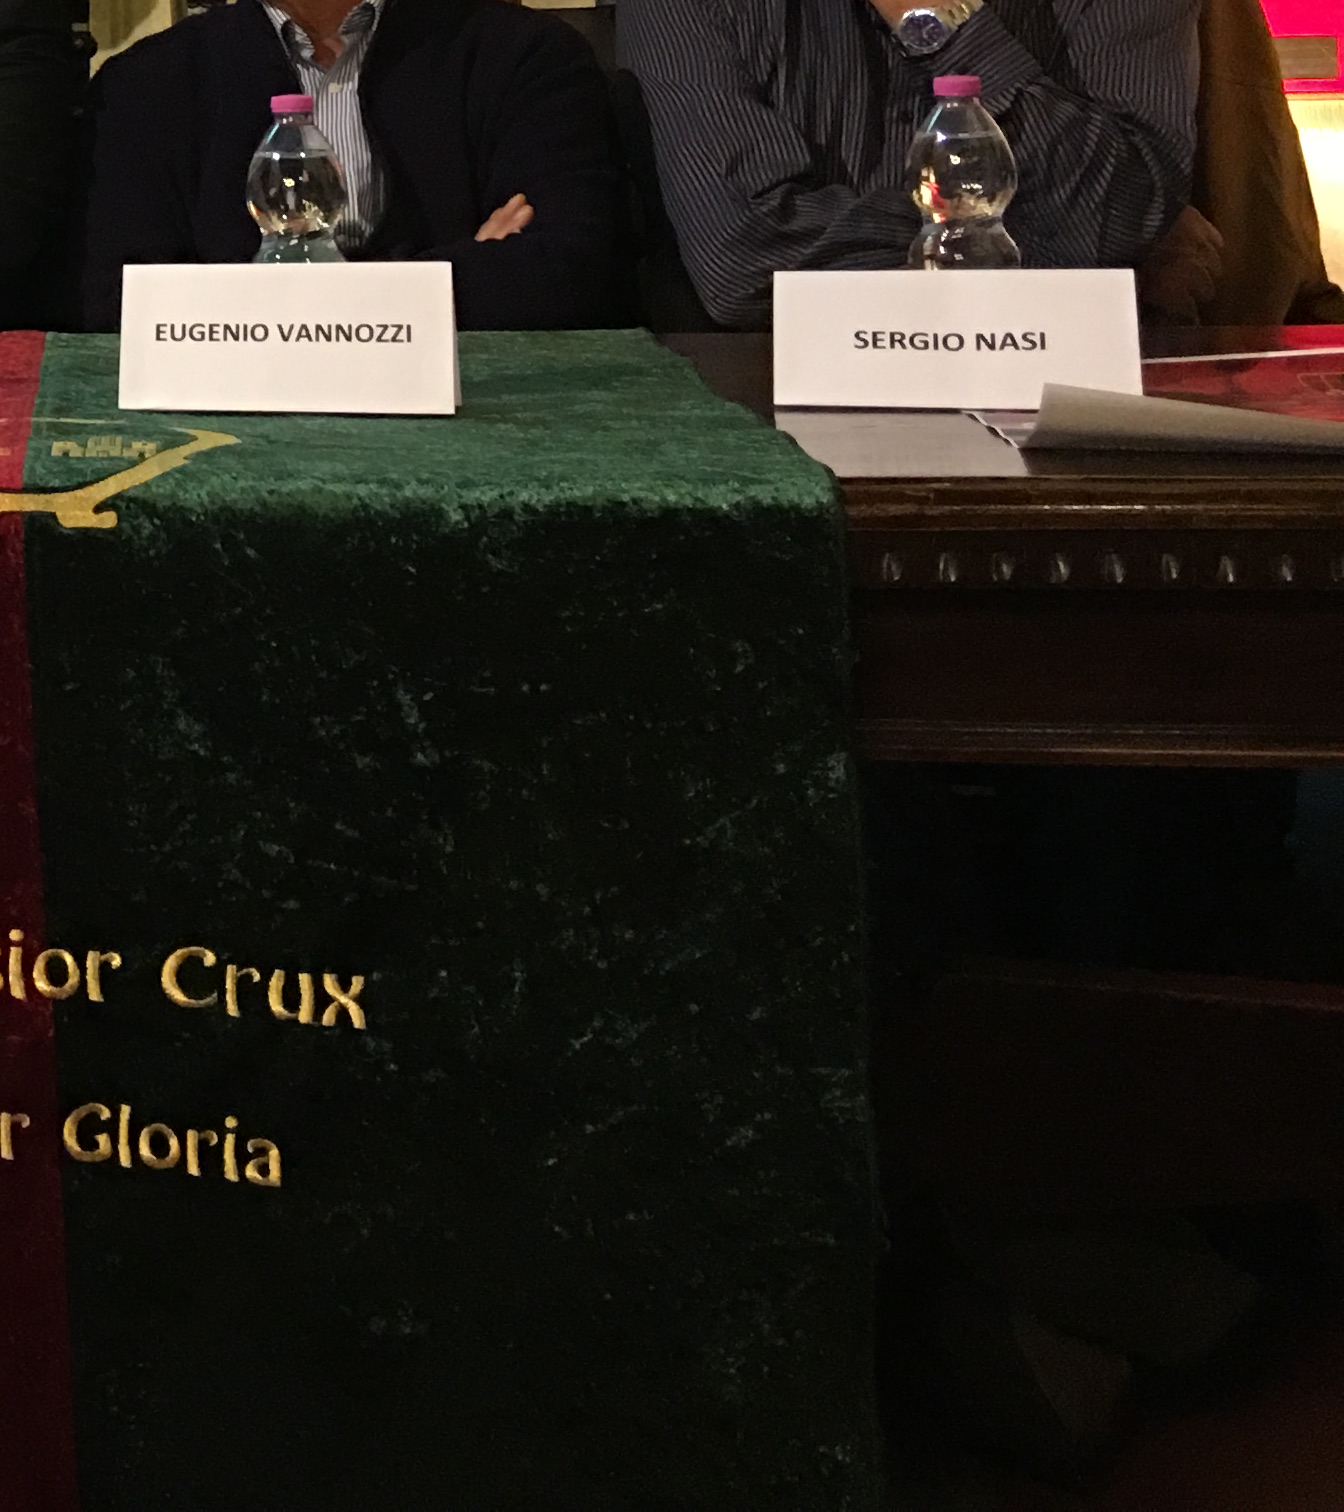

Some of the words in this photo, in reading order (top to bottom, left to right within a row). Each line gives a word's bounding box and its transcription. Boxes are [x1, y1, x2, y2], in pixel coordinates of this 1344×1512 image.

[155, 323, 269, 342] EUGENIO
[276, 323, 412, 343] VANNOZZI
[854, 330, 965, 352] SERGIO
[975, 331, 1046, 352] NASI
[160, 946, 366, 1030] Crux
[62, 1102, 281, 1187] Gloria
